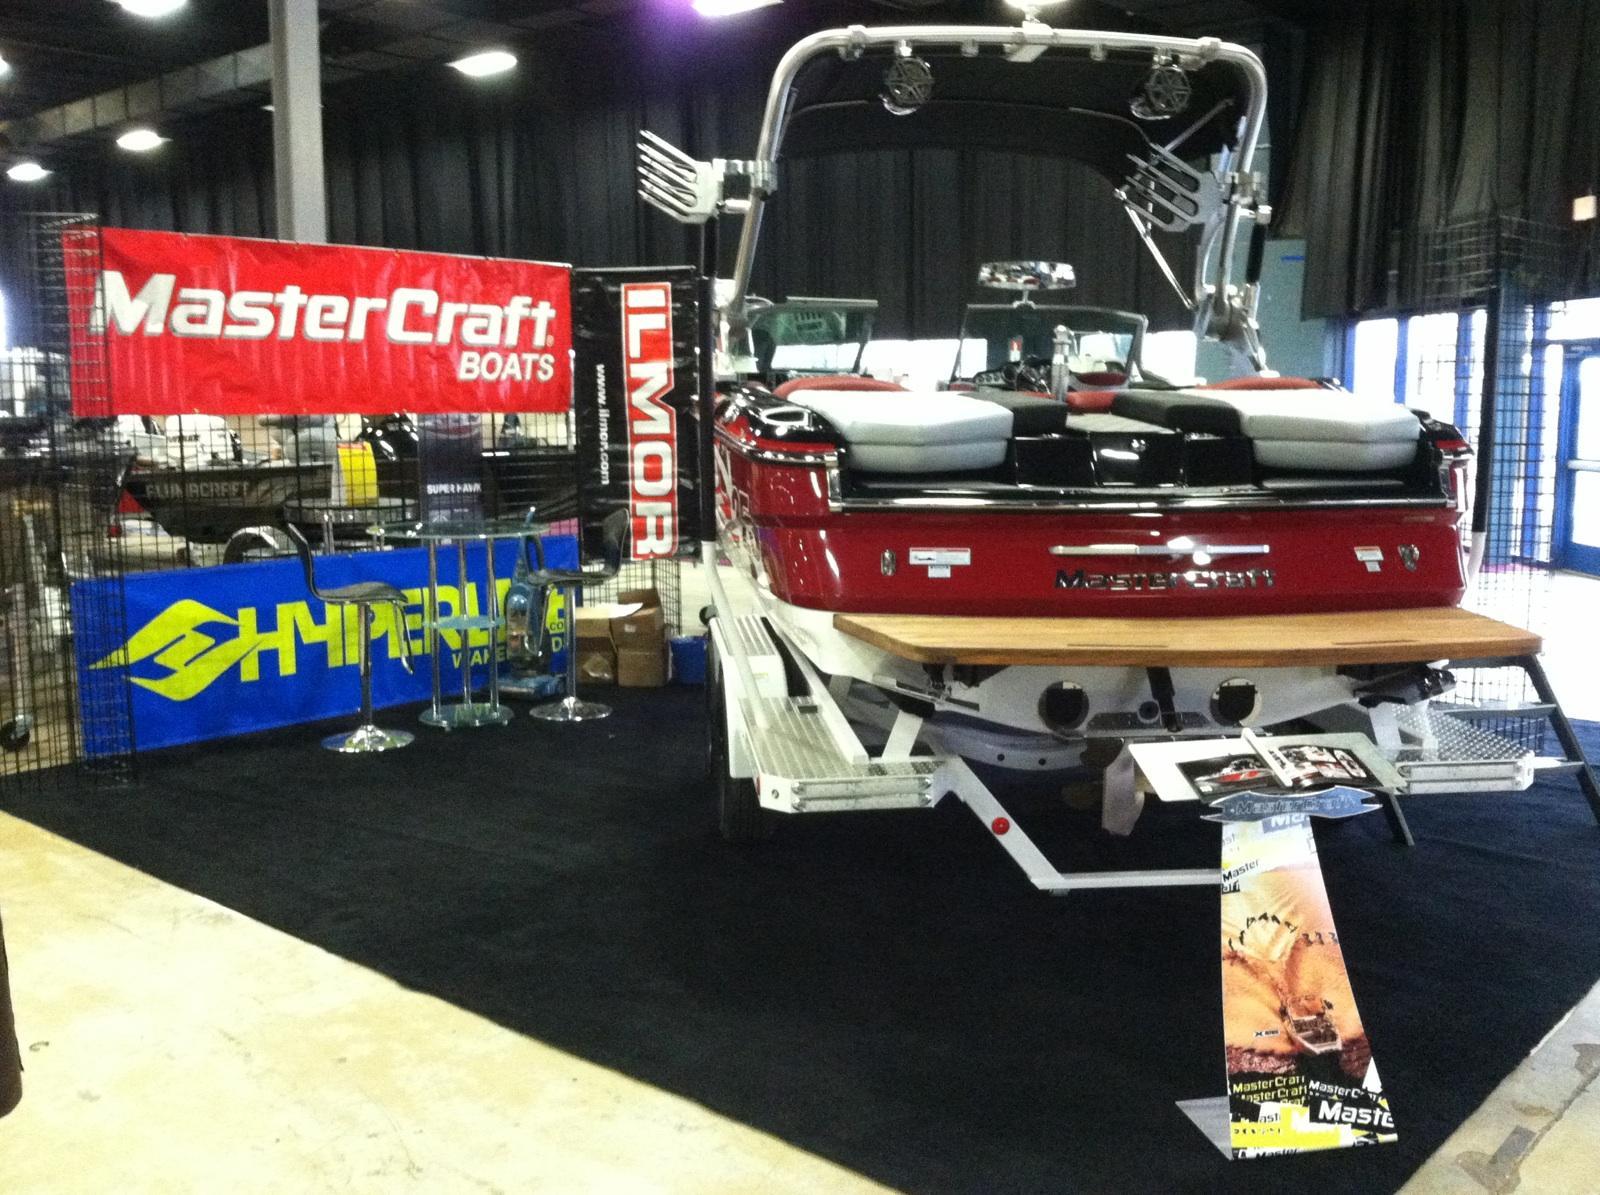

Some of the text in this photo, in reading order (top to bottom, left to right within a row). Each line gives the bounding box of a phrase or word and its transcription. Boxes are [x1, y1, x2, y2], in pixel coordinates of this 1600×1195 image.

[90, 269, 556, 346] MasterCraft
[459, 351, 555, 382] BOATS
[596, 364, 610, 485] www.ilmor.com
[626, 288, 673, 556] ILMOR
[427, 483, 455, 494] SUPER
[1055, 569, 1275, 589] MasterCraft
[238, 578, 565, 682] HYPERLIE
[1241, 1085, 1307, 1105] asterCraft
